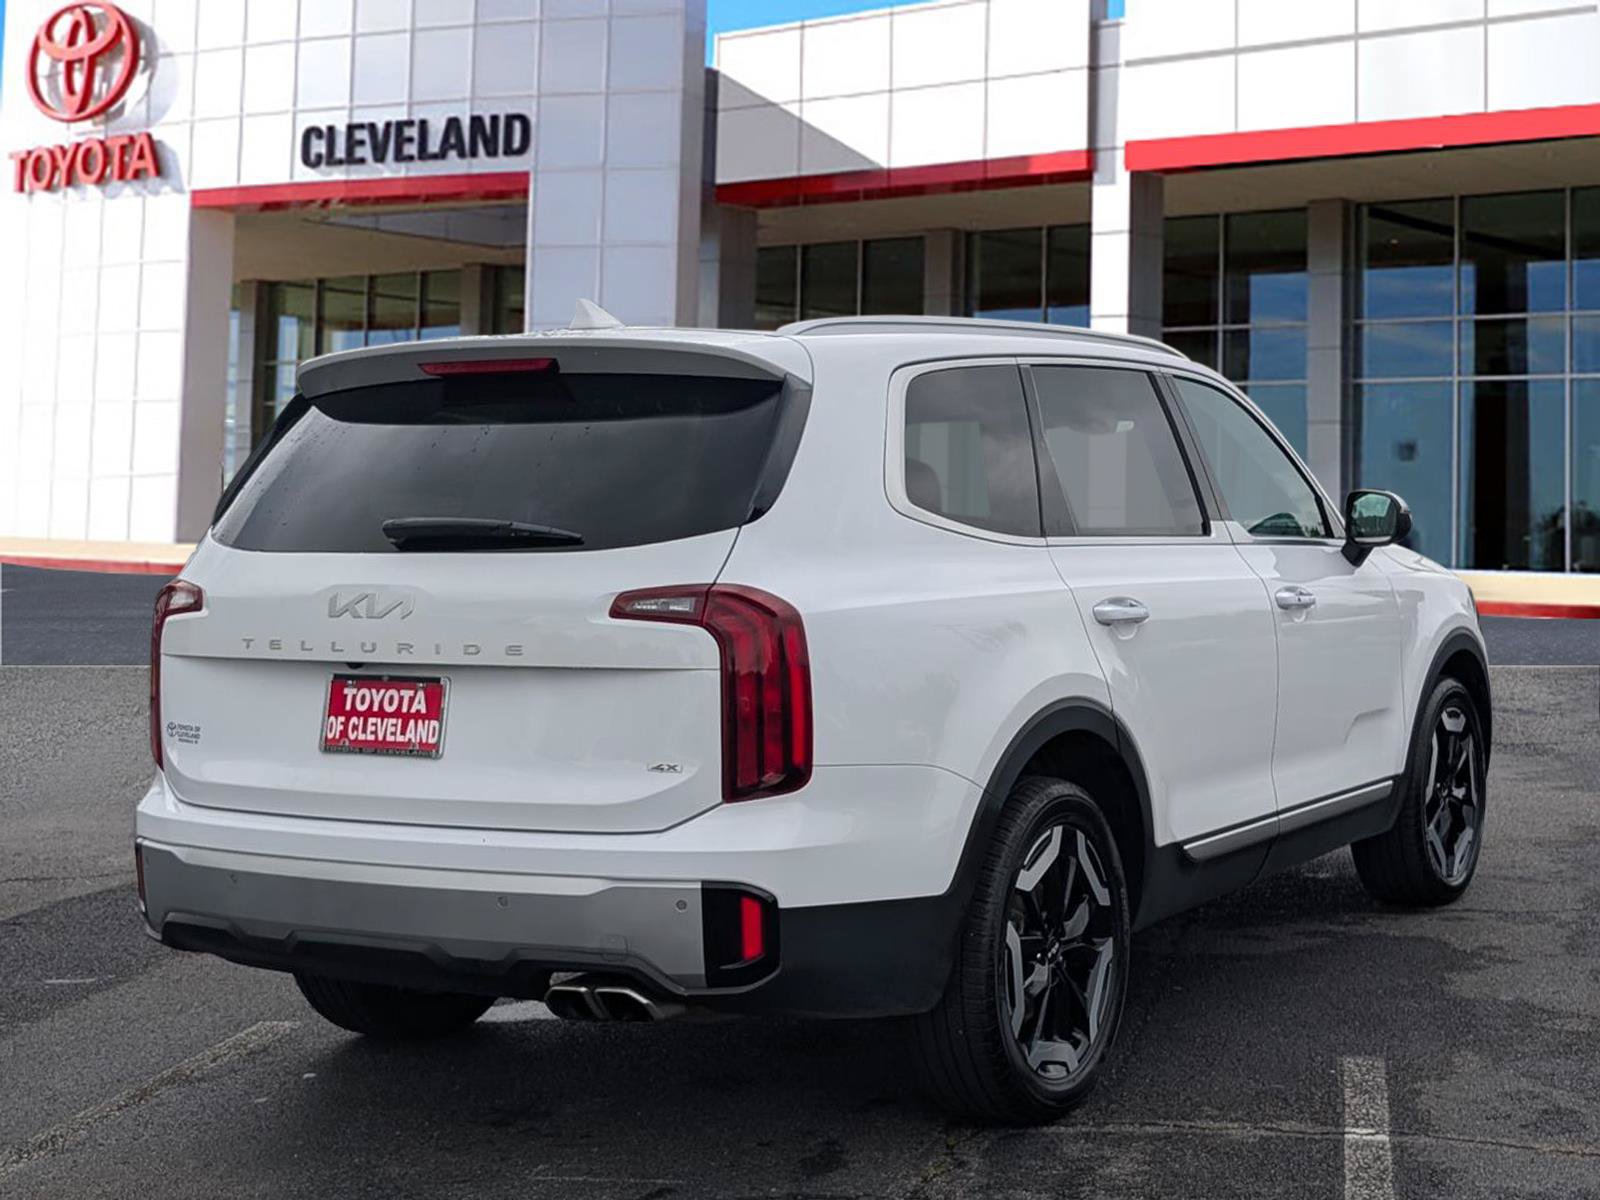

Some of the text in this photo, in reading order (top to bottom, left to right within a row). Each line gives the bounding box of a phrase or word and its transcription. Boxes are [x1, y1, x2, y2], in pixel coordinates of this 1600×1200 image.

[301, 113, 531, 168] CLEVELAND
[9, 131, 161, 193] TOYOTA
[242, 638, 524, 656] TELLURIDE
[343, 687, 427, 713] TOYOTA
[326, 715, 440, 744] OF CLEVELAND
